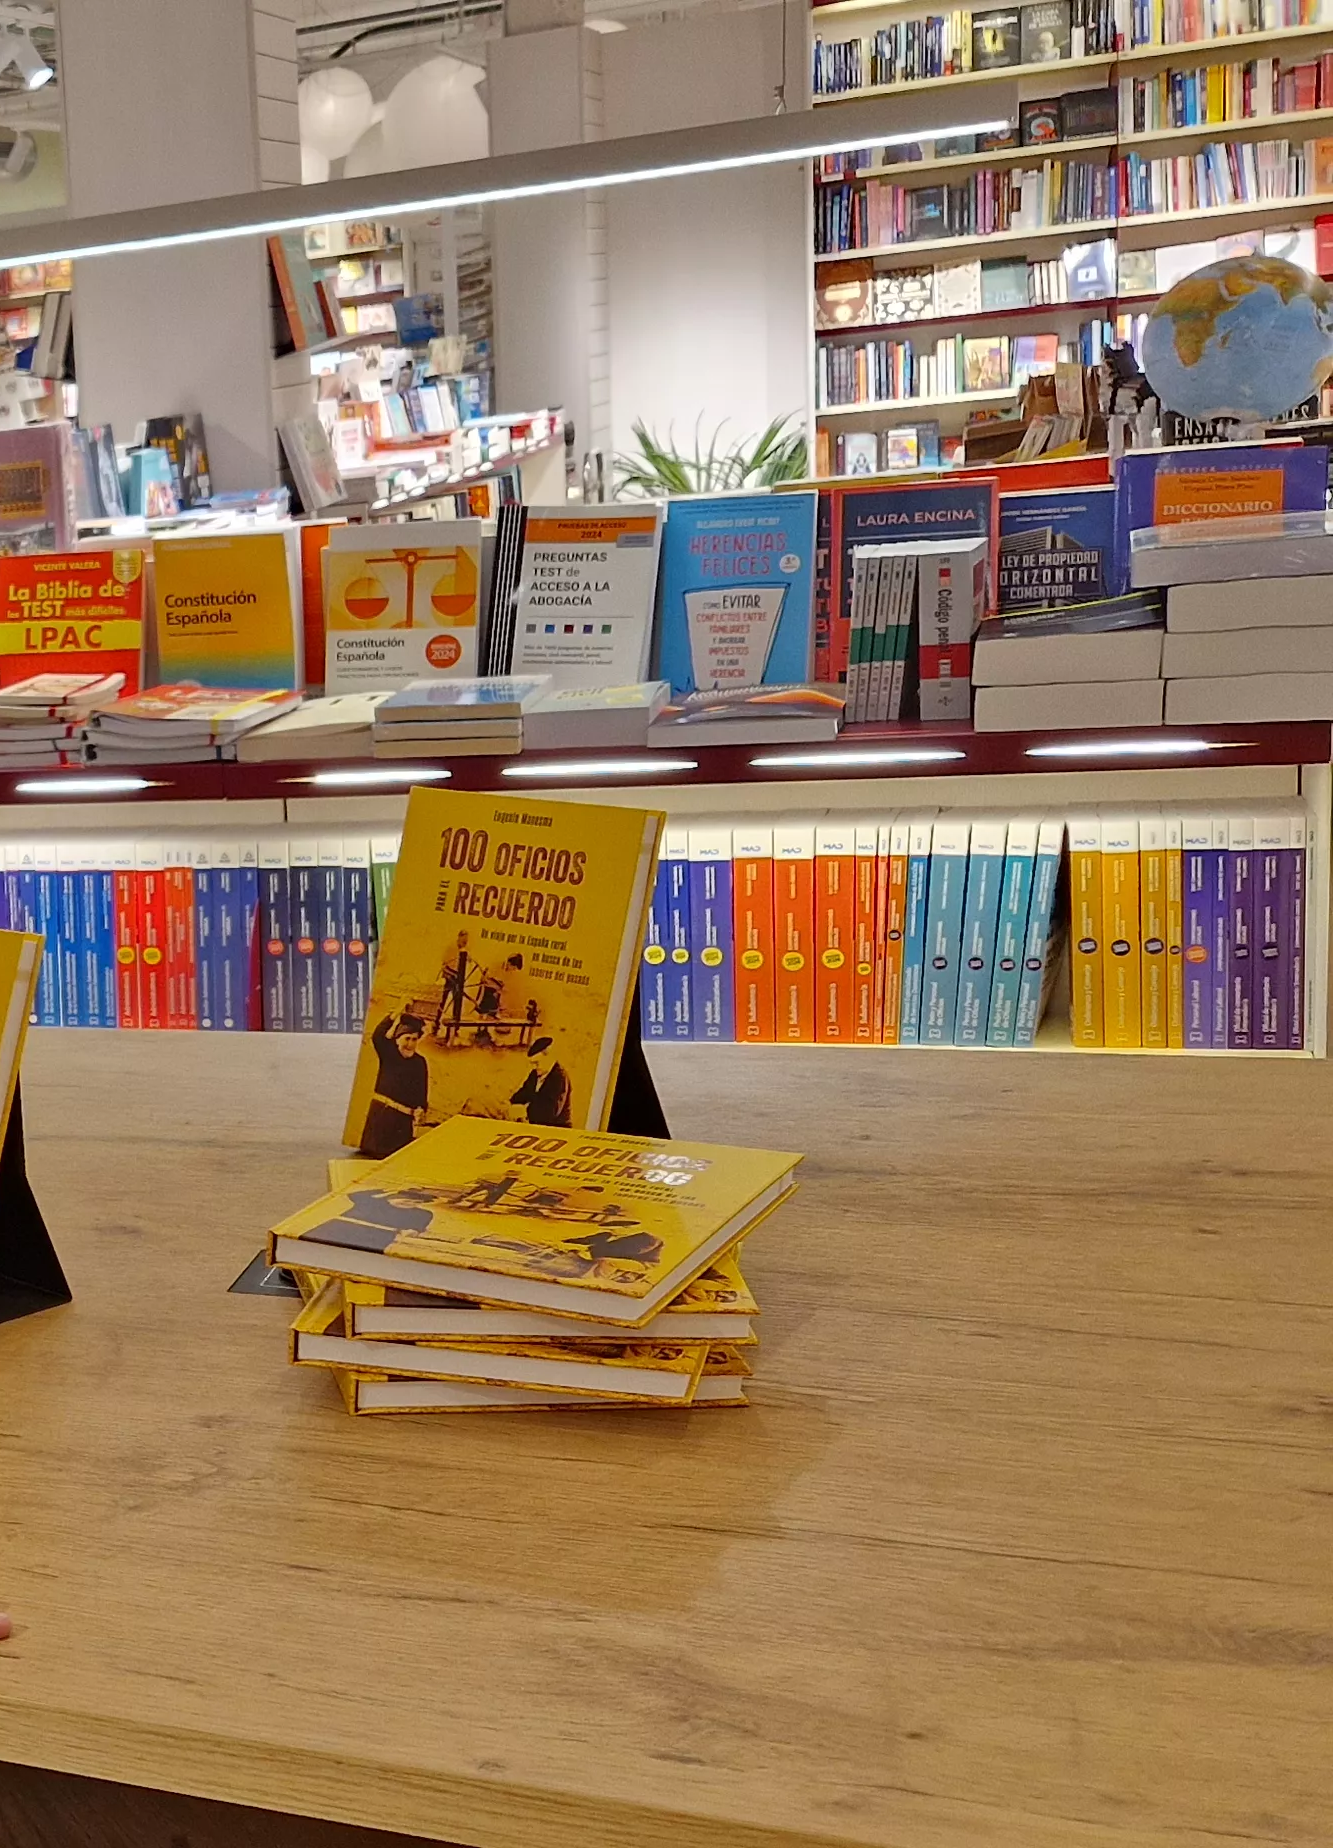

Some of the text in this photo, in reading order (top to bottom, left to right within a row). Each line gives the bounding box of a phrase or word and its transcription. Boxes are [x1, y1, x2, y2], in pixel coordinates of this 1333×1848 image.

[1163, 500, 1273, 516] DICCIONARIO
[856, 508, 976, 527] LAURA ENCINA
[581, 531, 603, 539] 2024
[690, 532, 787, 554] HERENCIAS
[533, 551, 607, 563] PREGUNTAS
[1002, 551, 1099, 569] LEY DE PROPIEDAD
[34, 561, 101, 572] VICENTE VALERA
[533, 566, 580, 577] TEST de
[701, 556, 771, 577] FELICES
[999, 567, 1099, 586] ORIZONTAL
[8, 580, 125, 601] La Biblia de
[530, 581, 610, 592] ACCESO A LA
[1009, 583, 1073, 600] COMENTADA
[165, 590, 257, 609] Constitución
[529, 594, 593, 606] ABOGACÍA
[723, 594, 761, 609] EVITAR
[934, 589, 952, 623] Código
[21, 601, 64, 618] TEST
[743, 611, 767, 621] ENTRE
[166, 609, 232, 628] Española
[24, 624, 103, 651] LPAC
[337, 636, 405, 649] Constitución
[337, 651, 385, 663] Española
[431, 649, 455, 661] 2024
[493, 810, 553, 827] Eugenio Monesma
[439, 827, 587, 886] 100 OFICIOS
[435, 879, 450, 912] PARA EL
[453, 881, 577, 930] RECUERDO
[506, 932, 517, 945] por
[527, 934, 549, 949] España
[550, 938, 567, 951] rural
[532, 952, 540, 962] en
[541, 951, 561, 965] busca
[562, 955, 571, 967] de
[566, 972, 590, 987] pasado
[488, 1132, 568, 1153] 100
